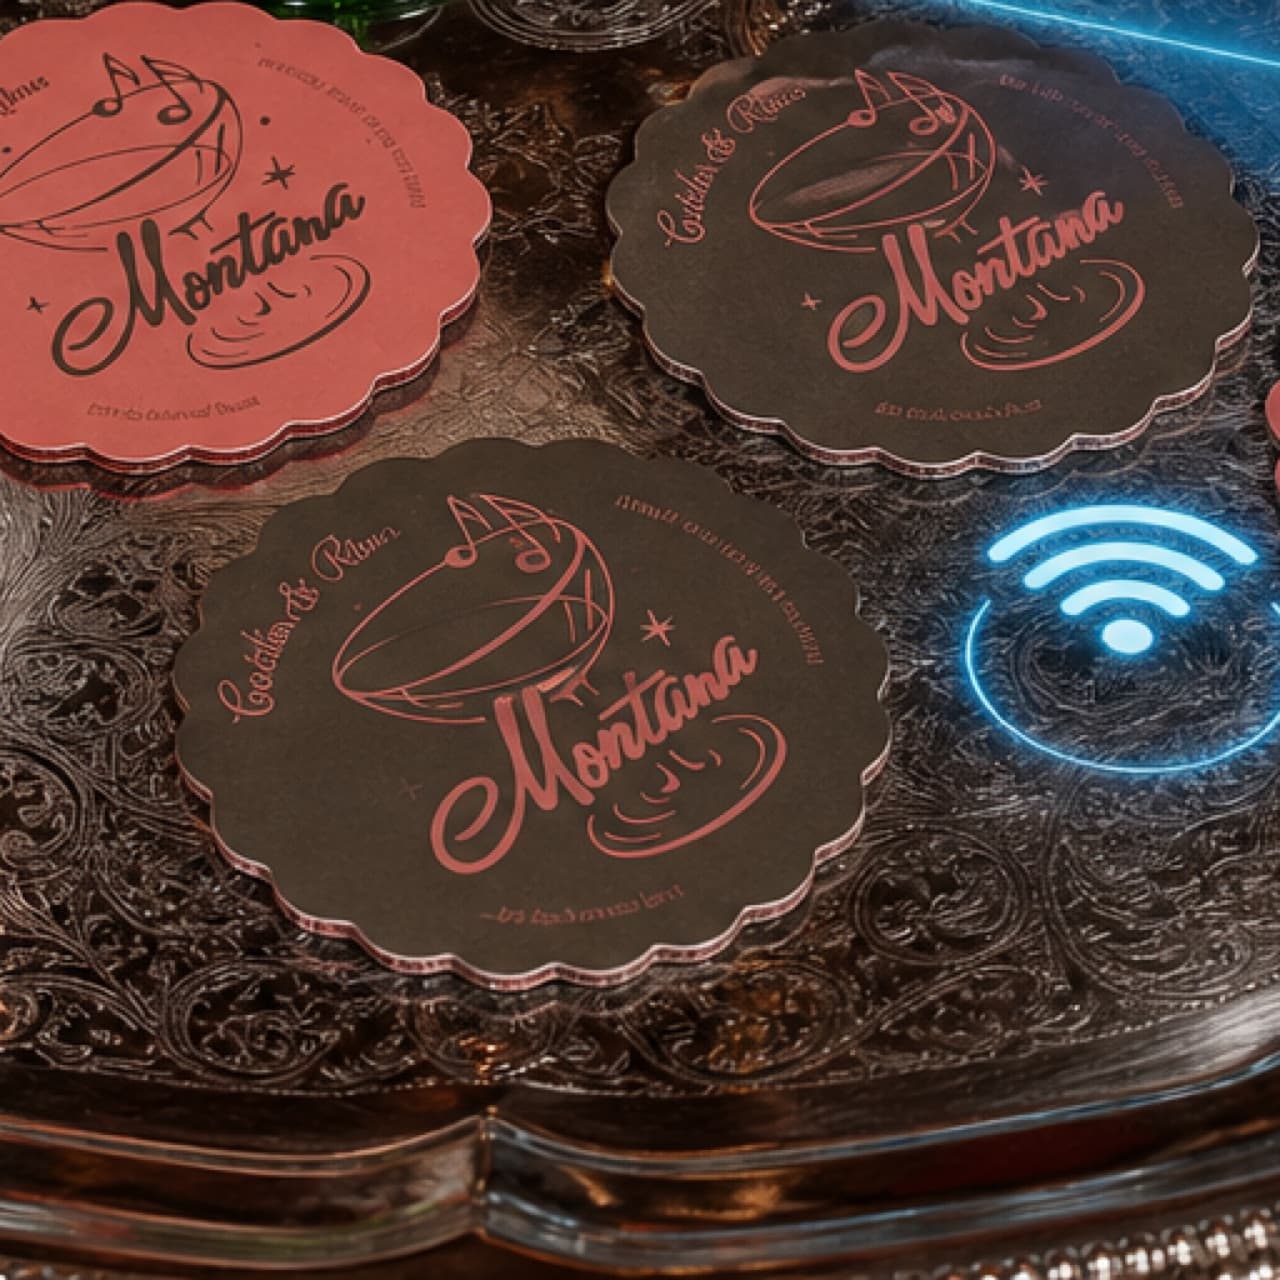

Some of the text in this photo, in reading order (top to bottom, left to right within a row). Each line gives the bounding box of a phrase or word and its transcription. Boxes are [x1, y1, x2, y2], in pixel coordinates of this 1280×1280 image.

[52, 182, 367, 377] Montana
[827, 190, 1124, 374] Montana
[431, 635, 758, 874] Montana
